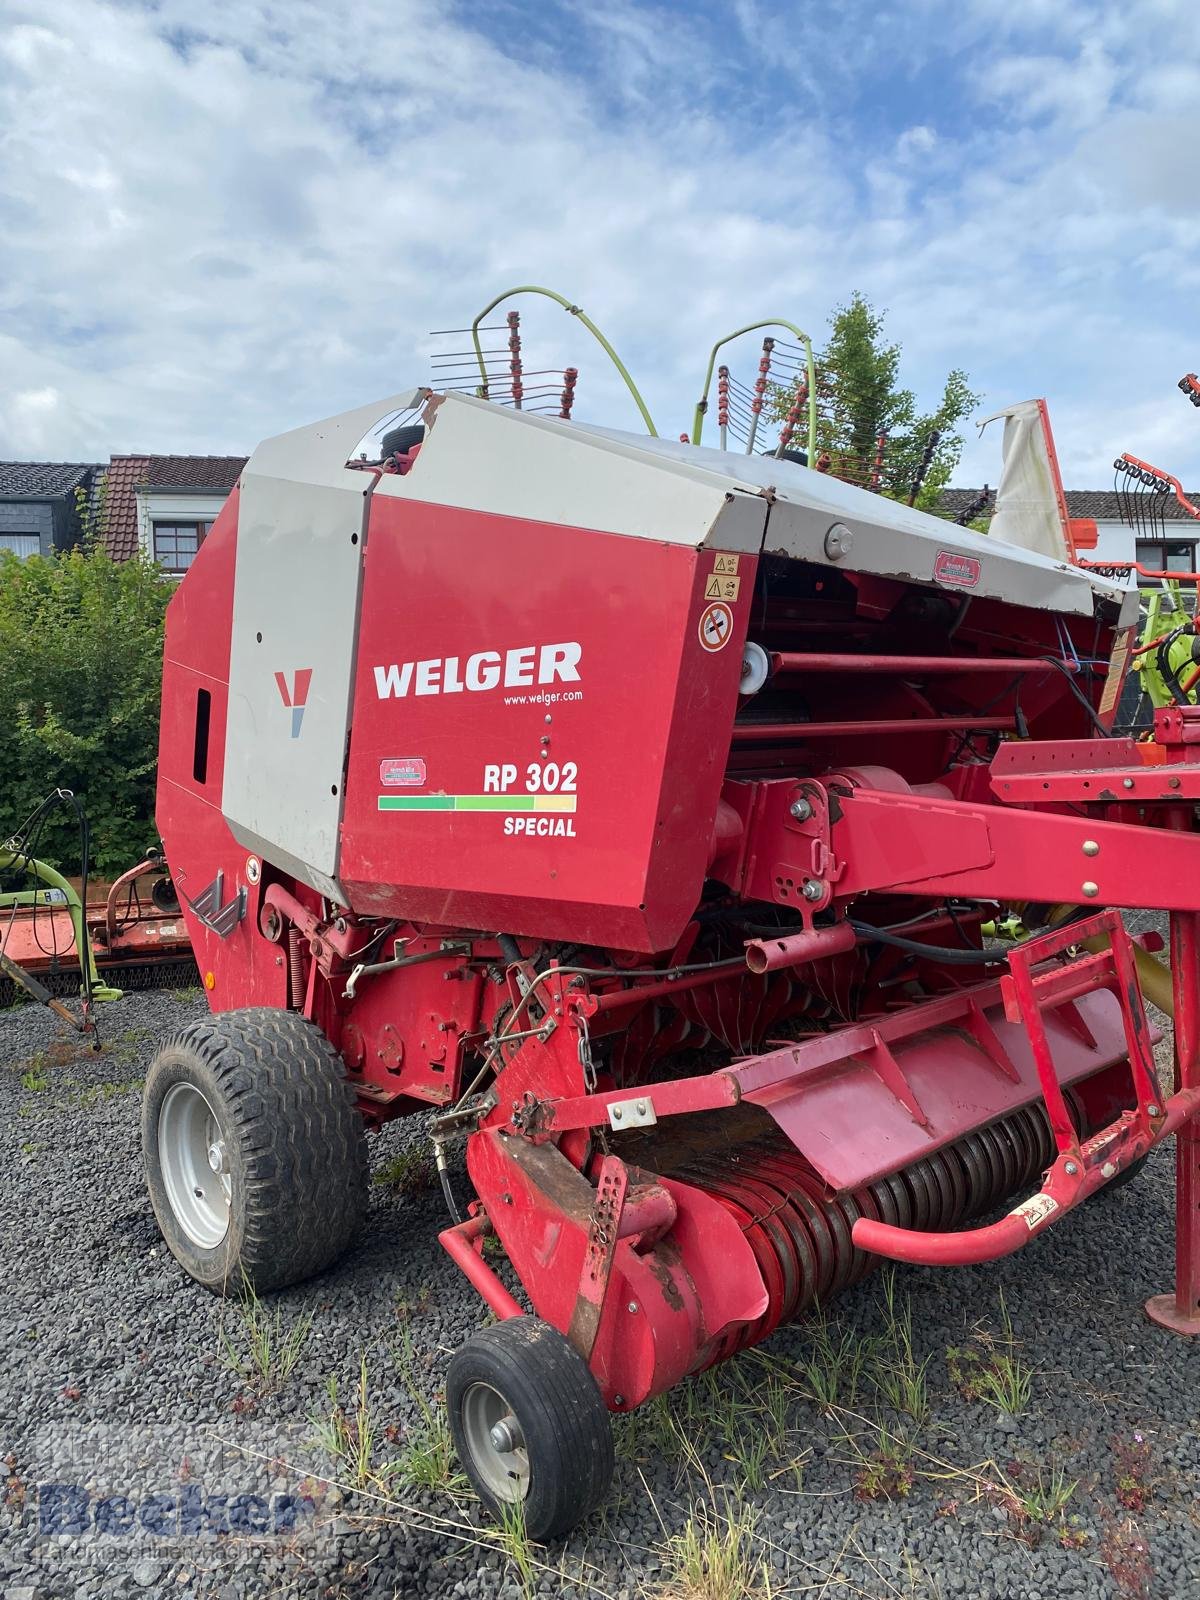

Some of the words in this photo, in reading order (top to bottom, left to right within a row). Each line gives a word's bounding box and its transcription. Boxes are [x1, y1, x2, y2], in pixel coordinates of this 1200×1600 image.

[373, 641, 582, 700] WELGER
[503, 689, 583, 706] www.welger.com
[483, 764, 518, 792] RP
[525, 761, 578, 792] 302
[503, 816, 577, 837] SPECIAL
